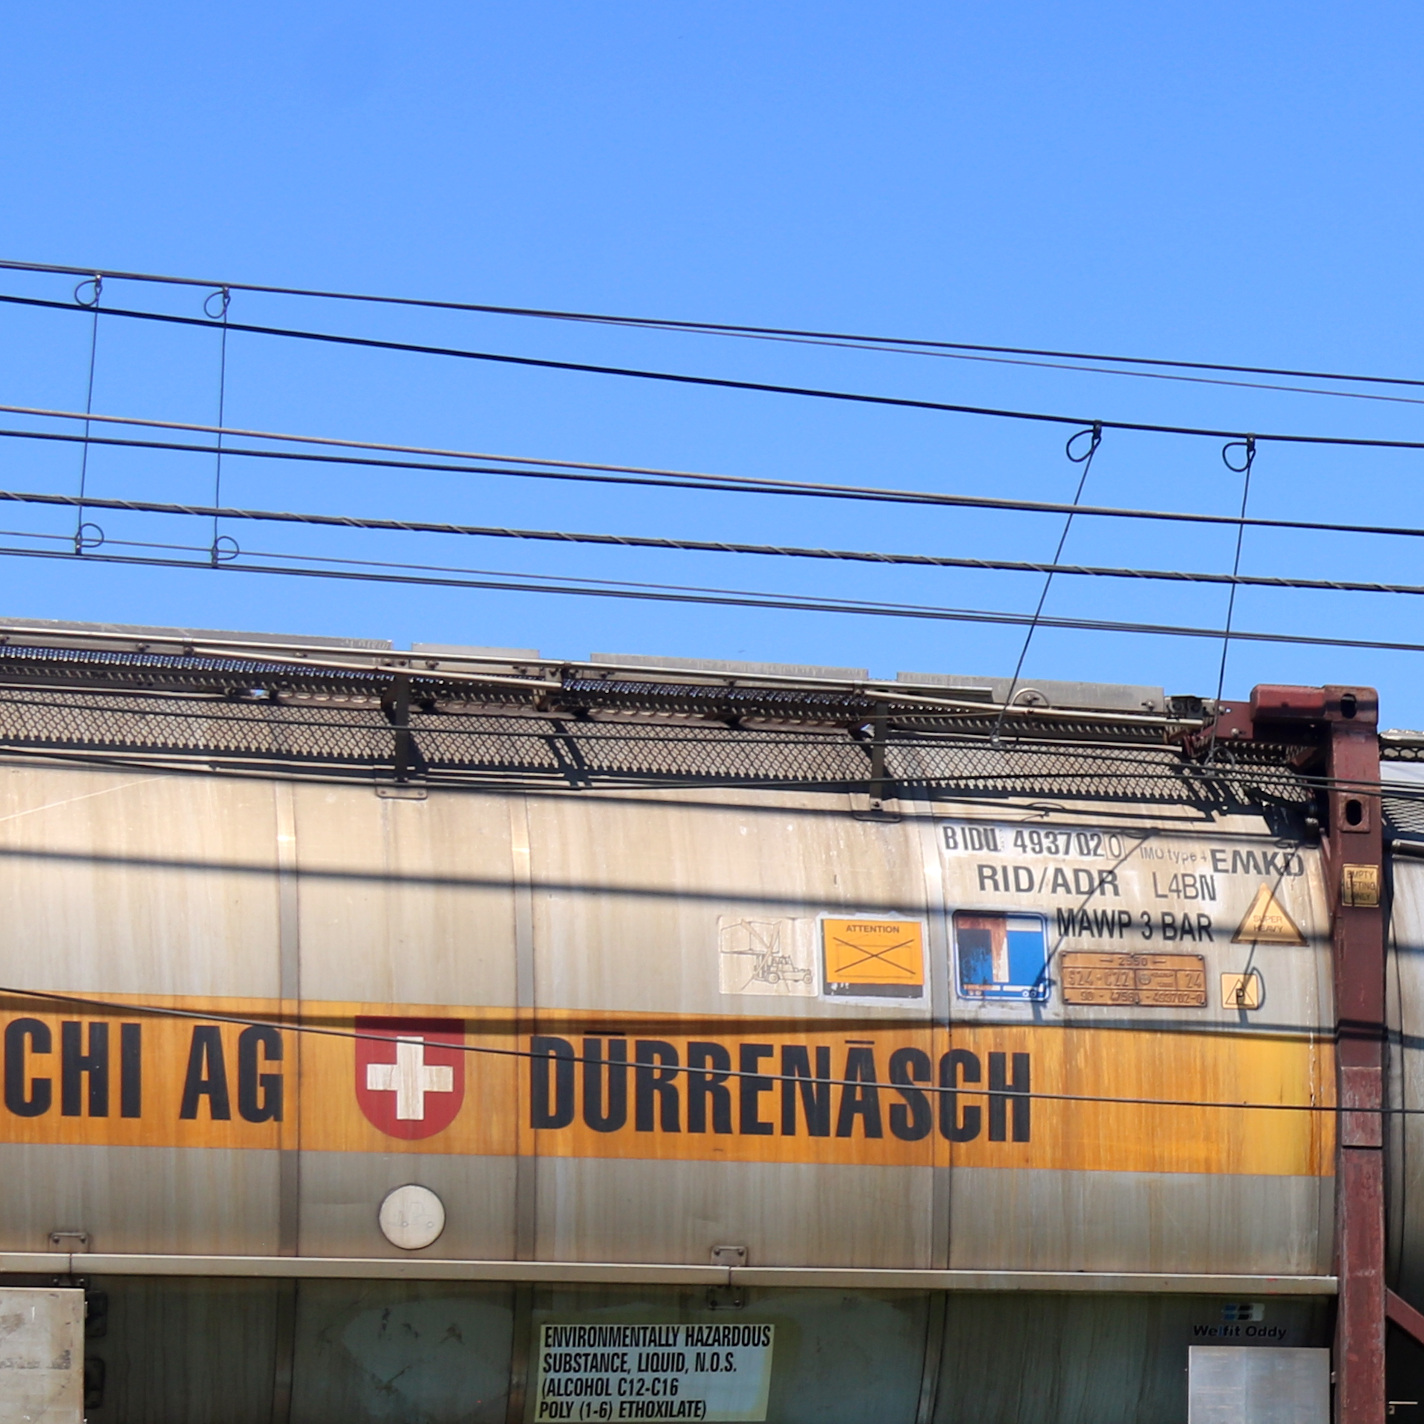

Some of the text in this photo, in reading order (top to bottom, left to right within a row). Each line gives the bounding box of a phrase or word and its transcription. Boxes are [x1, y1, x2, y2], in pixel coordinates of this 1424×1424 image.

[977, 864, 1217, 901] RID/ADR L4BN
[1346, 870, 1374, 879] EMPTY
[1345, 882, 1376, 891] LIFTING
[846, 925, 900, 934] ATTENTION
[1057, 907, 1215, 942] MAWP 3 BAR
[1253, 915, 1284, 933] SUPER HEAVY
[4, 1017, 284, 1123] CHI AG
[544, 1325, 771, 1348] ENVIRONMENTALLY HAZARDOUS
[1193, 1325, 1287, 1341] Welfit Oddy
[542, 1352, 738, 1375] SUBSTANCE, LIQUID, N.O.S.
[541, 1377, 679, 1400] (ALCOHOL C12-C16
[539, 1400, 707, 1420] POLY (1-6) ETHOXILATE)
